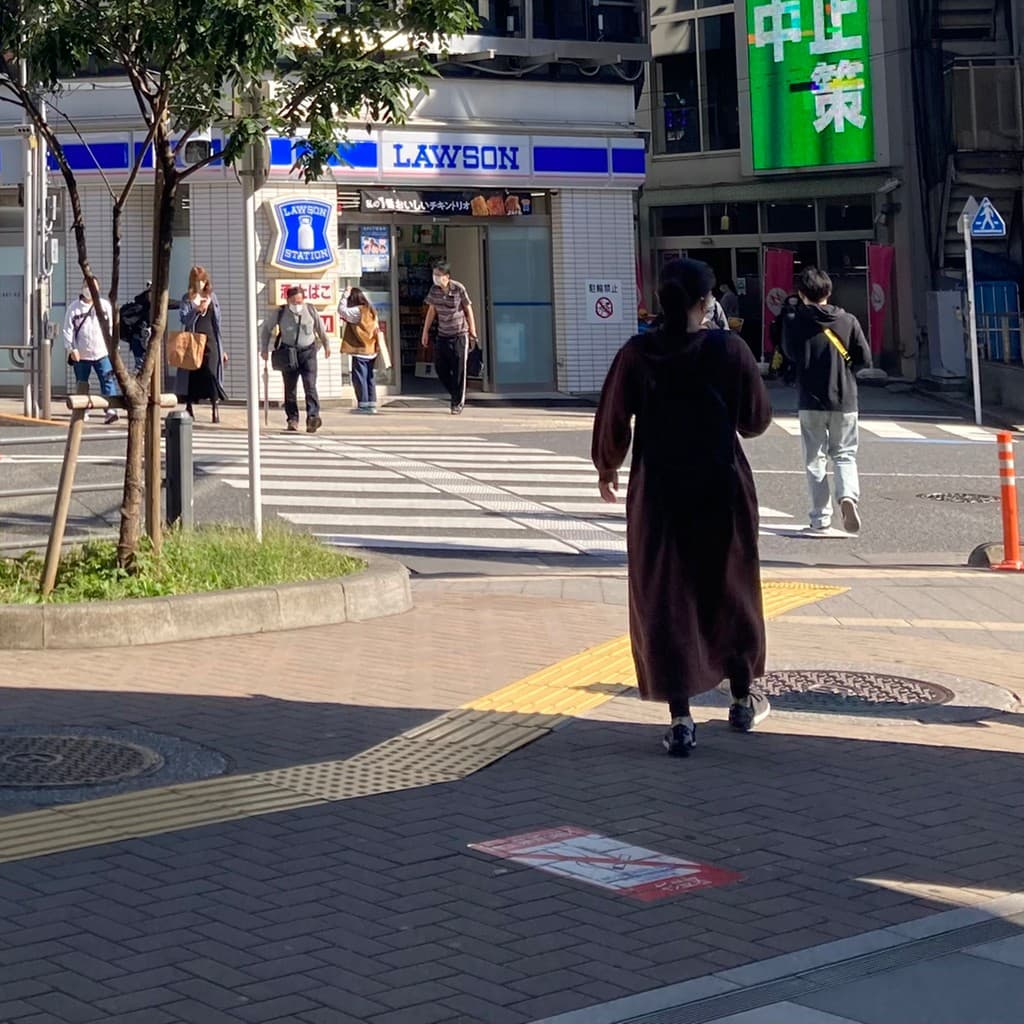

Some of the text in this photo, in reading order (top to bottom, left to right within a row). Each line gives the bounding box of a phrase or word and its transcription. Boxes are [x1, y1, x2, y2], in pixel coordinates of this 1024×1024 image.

[393, 144, 519, 170] LAWSON
[282, 204, 328, 217] LAWSON
[284, 249, 329, 261] STATION
[589, 283, 618, 294] 駐輪禁止
